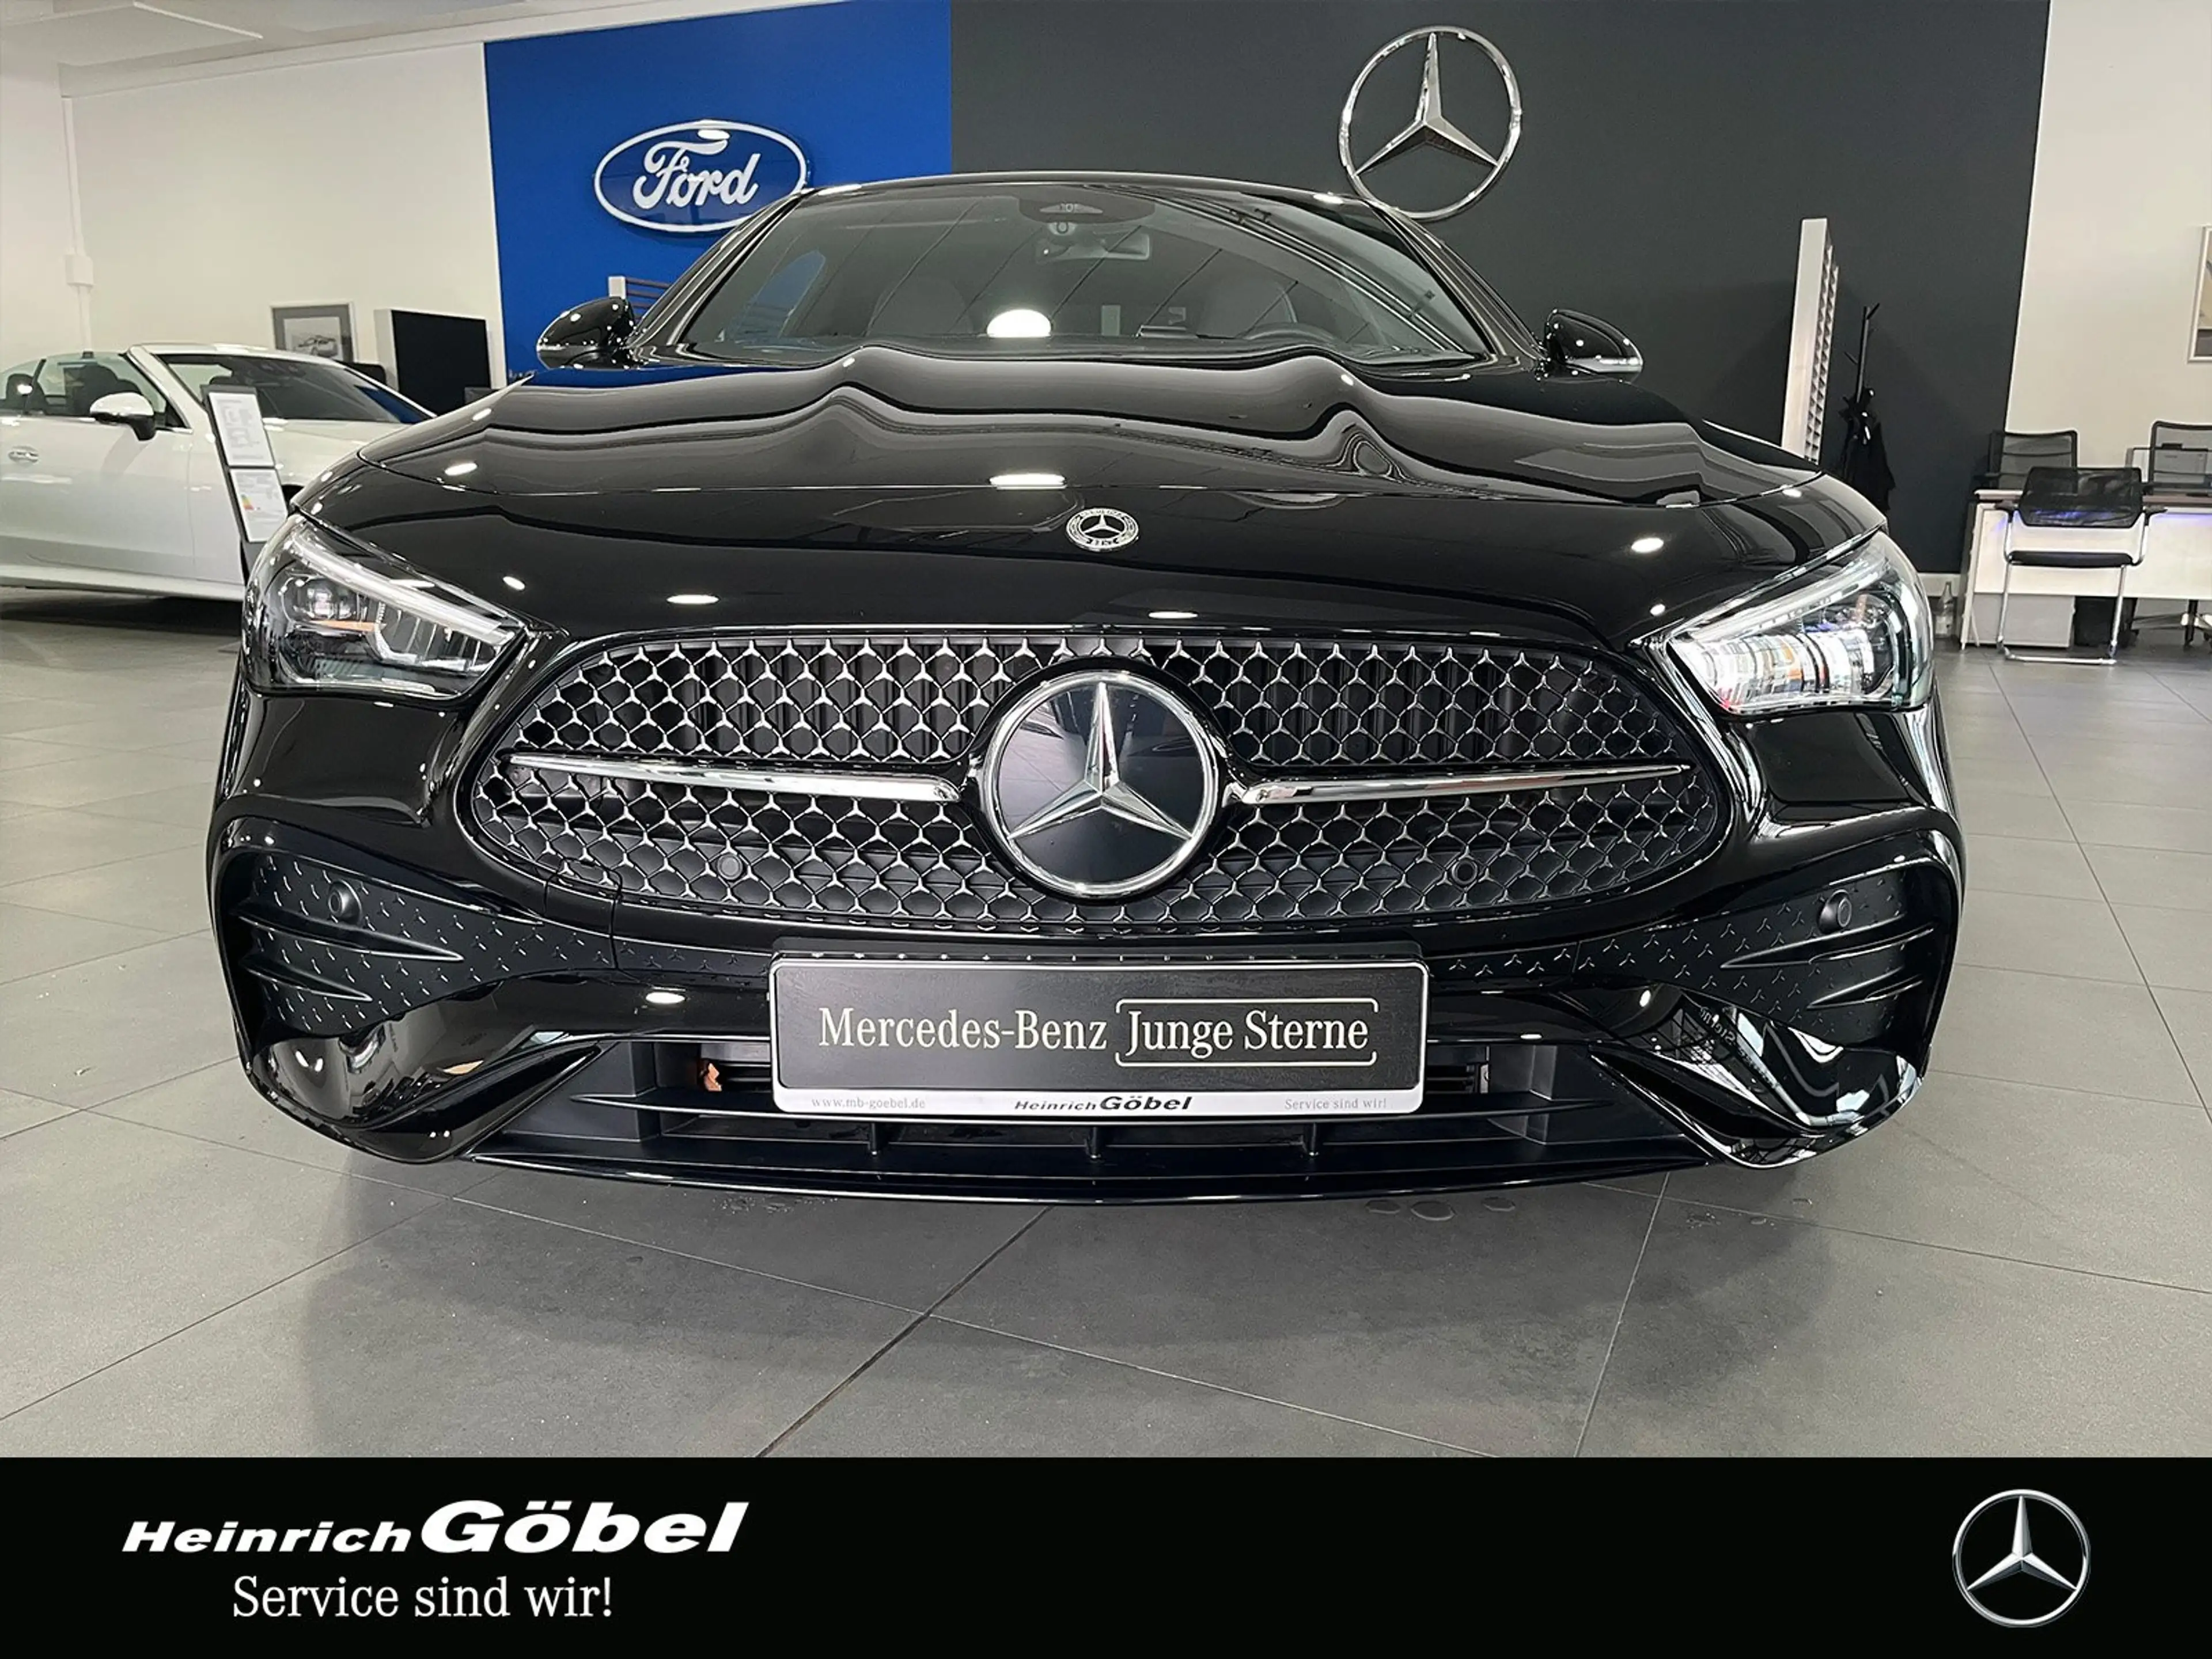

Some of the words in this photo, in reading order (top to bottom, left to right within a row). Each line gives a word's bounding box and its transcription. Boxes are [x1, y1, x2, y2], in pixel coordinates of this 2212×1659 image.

[633, 140, 761, 210] Ford
[819, 1007, 1108, 1050] Mercedes-Benz
[1125, 1010, 1233, 1059] Junge
[1244, 1009, 1369, 1051] Sterne
[812, 1097, 926, 1109] www.mb-goebel.de
[1014, 1100, 1096, 1110] Heinrich
[1100, 1096, 1192, 1110] Göbel
[1285, 1098, 1330, 1109] Service
[1334, 1098, 1359, 1109] sind
